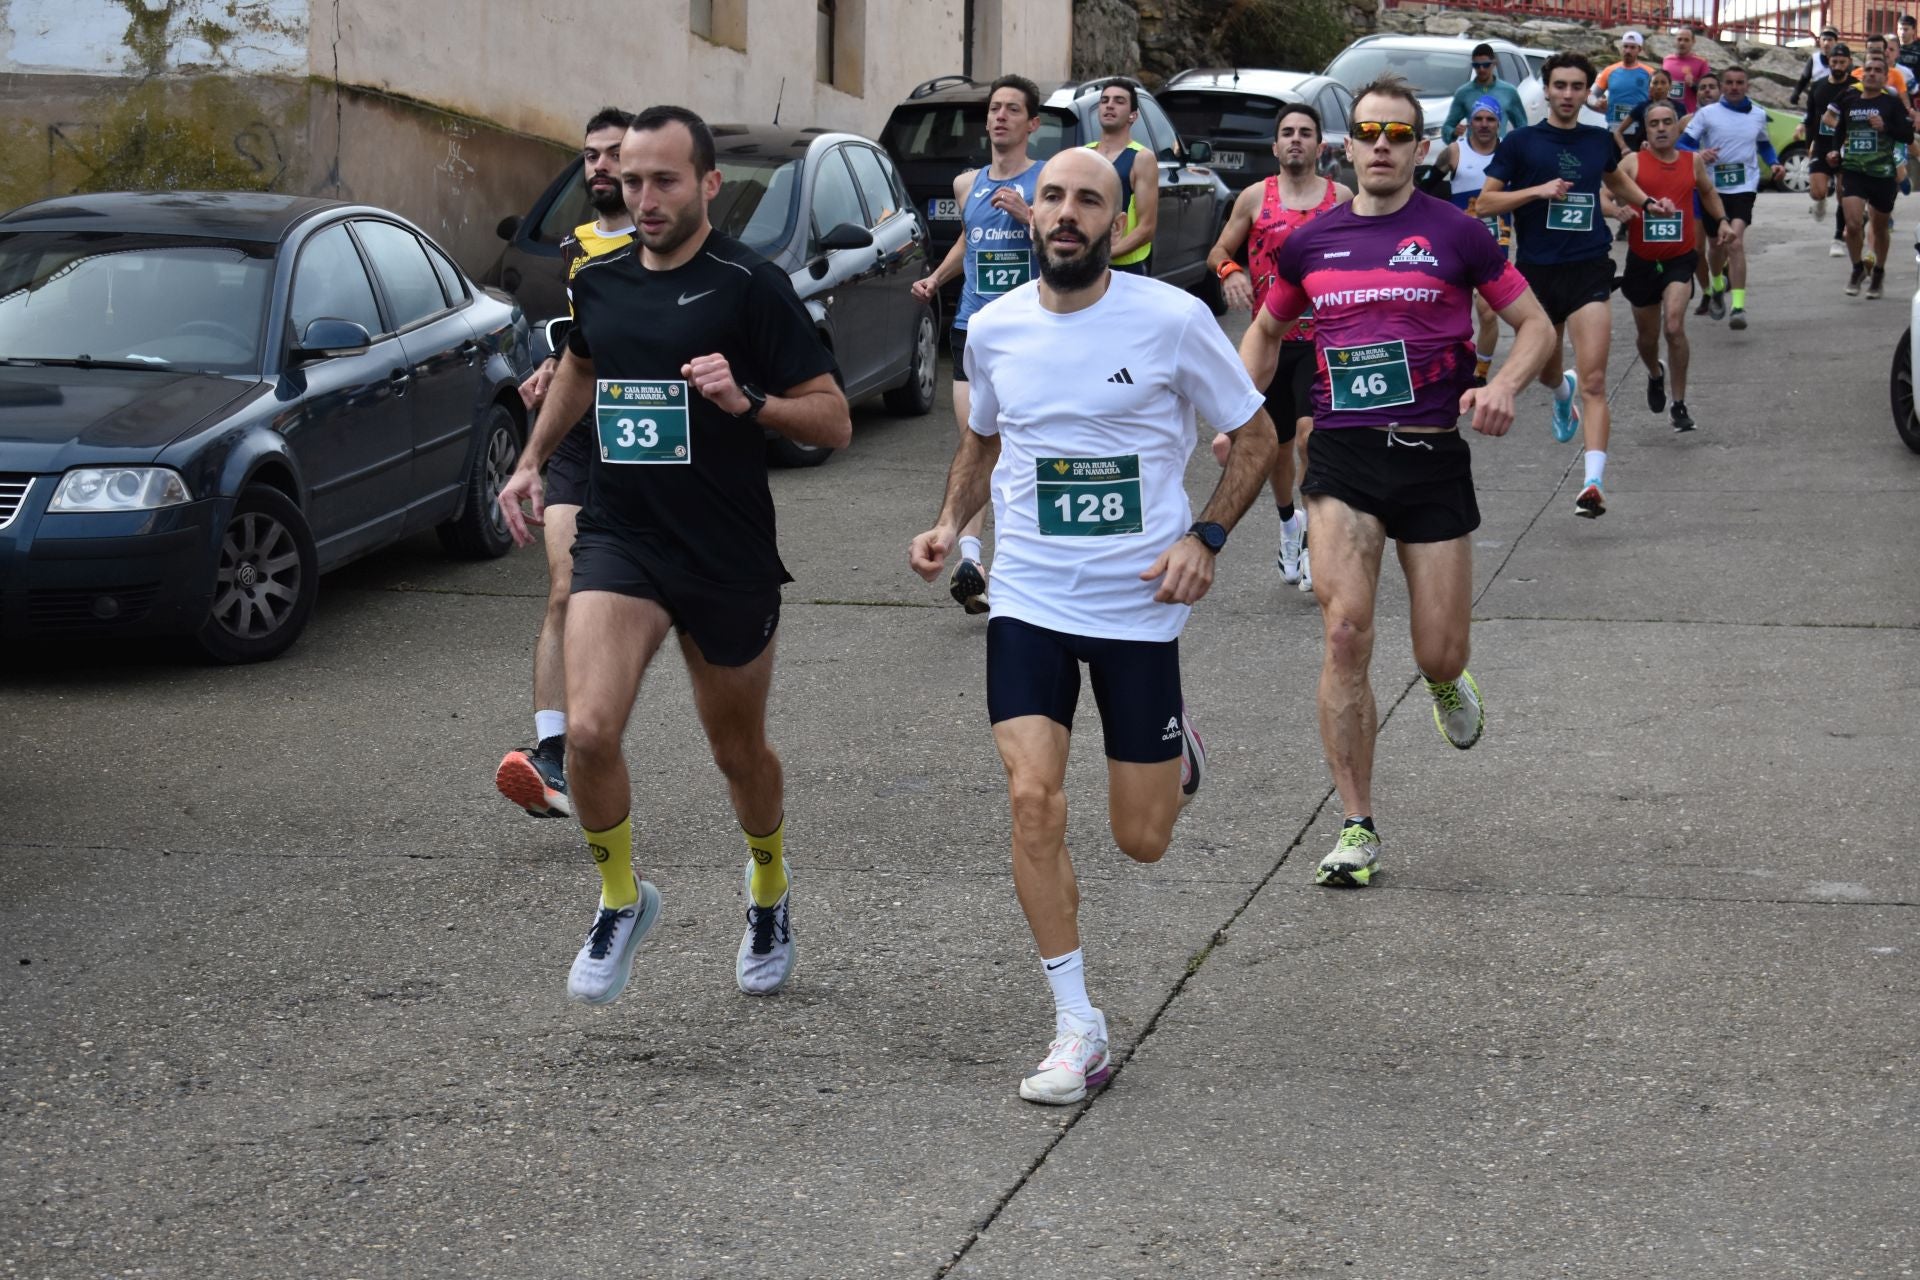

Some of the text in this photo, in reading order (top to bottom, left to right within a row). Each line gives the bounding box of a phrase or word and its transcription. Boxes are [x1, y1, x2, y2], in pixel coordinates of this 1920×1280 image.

[1848, 108, 1879, 116] DESAFÍO
[1852, 140, 1873, 150] 123
[1219, 153, 1241, 164] KMN
[1722, 173, 1738, 183] 13
[938, 201, 960, 215] 92
[1561, 209, 1583, 224] 22
[985, 227, 1024, 240] Chiruca
[1649, 224, 1677, 236] 153
[985, 269, 1021, 286] 127
[1325, 287, 1441, 307] INTERSPORT
[1361, 353, 1389, 361] NAVARRA
[640, 386, 663, 394] RURAL
[1351, 372, 1387, 398] 46
[616, 418, 659, 448] 33
[1092, 461, 1117, 469] RURAL
[1073, 467, 1120, 476] DE NAVARRA
[1054, 492, 1124, 523] 128
